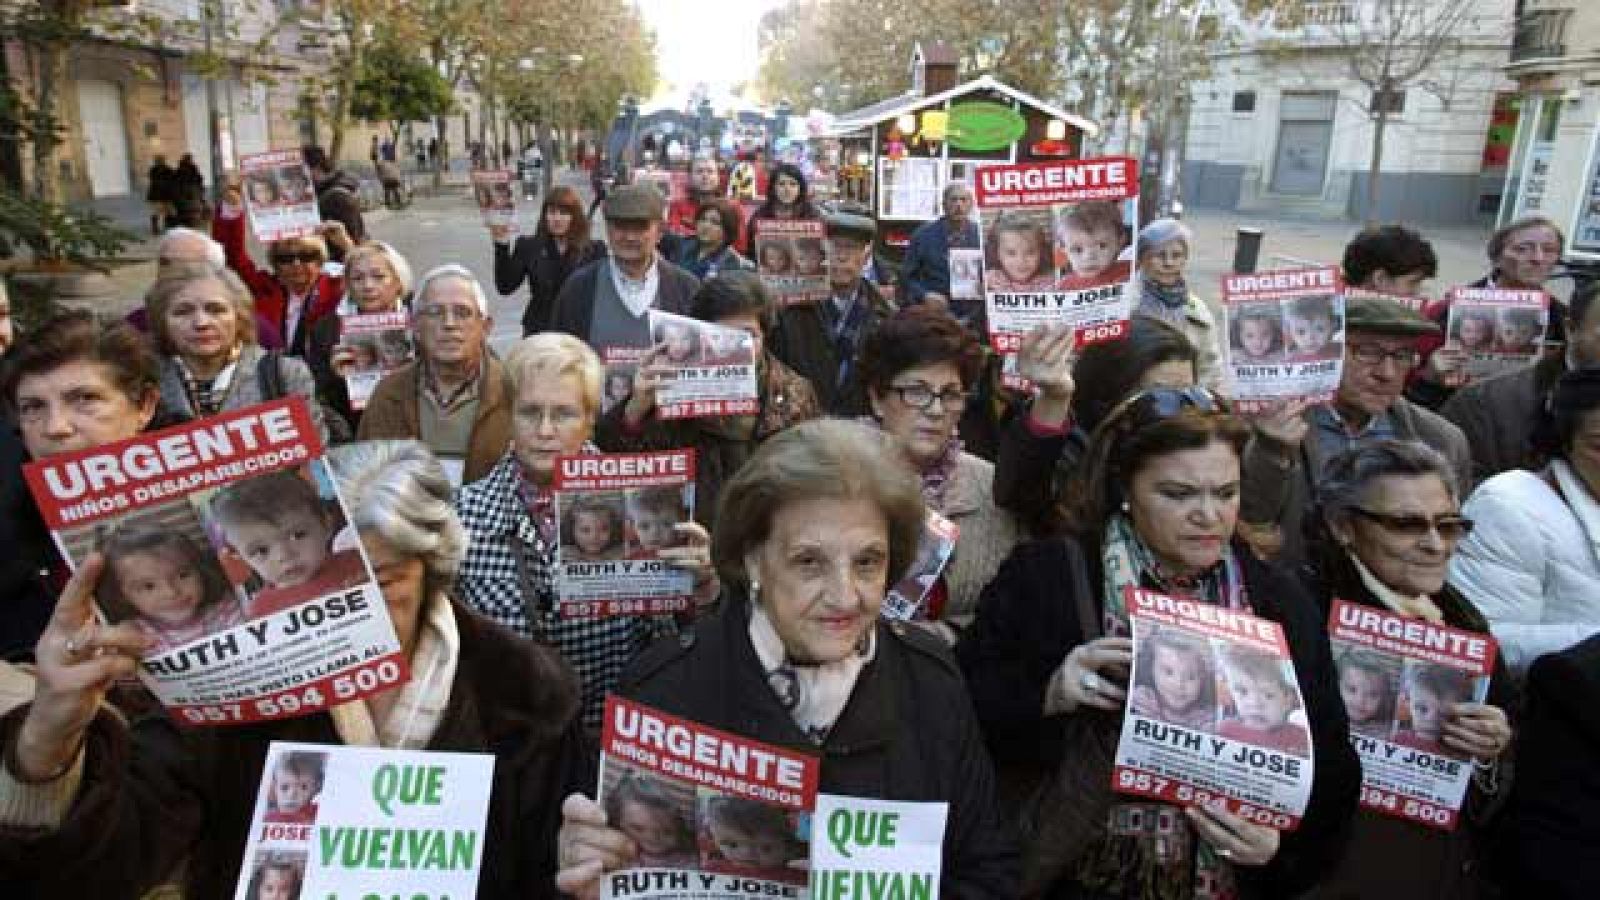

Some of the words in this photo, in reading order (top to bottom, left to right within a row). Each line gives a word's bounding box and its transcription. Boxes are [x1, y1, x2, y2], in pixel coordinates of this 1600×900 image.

[982, 162, 1126, 191] URGENTE
[995, 294, 1047, 308] RUTH
[1054, 294, 1066, 306] Y
[1072, 287, 1122, 305] JOSE
[1227, 269, 1335, 292] URGENTE
[996, 335, 1021, 351] 95
[1084, 324, 1122, 342] 500
[43, 407, 299, 499] URGENTE
[561, 454, 688, 478] URGENTE
[59, 495, 130, 523] NIÑOS
[134, 445, 309, 504] DESAPARECIDOS
[567, 561, 616, 576] RUTH
[622, 561, 634, 573] Y
[142, 634, 240, 676] RUTH
[246, 621, 269, 646] Y
[282, 588, 370, 637] JOSE
[1135, 589, 1277, 640] URGENTE
[1339, 604, 1487, 659] URGENTE
[181, 703, 242, 722] 957
[255, 688, 326, 717] 594
[330, 660, 401, 699] 500
[614, 704, 805, 789] URGENTE
[1134, 719, 1200, 750] RUTH
[1209, 739, 1227, 756] Y
[1232, 747, 1301, 777] JOSE
[1384, 744, 1398, 759] Y
[1402, 752, 1462, 776] JOSE
[371, 763, 448, 816] QUE
[1119, 769, 1170, 794] 957
[1404, 800, 1451, 825] 500
[261, 826, 314, 842] JOSE
[319, 826, 477, 871] VUELVAN
[827, 808, 901, 858] QUE
[611, 871, 690, 898] RUTH
[699, 873, 717, 891] Y
